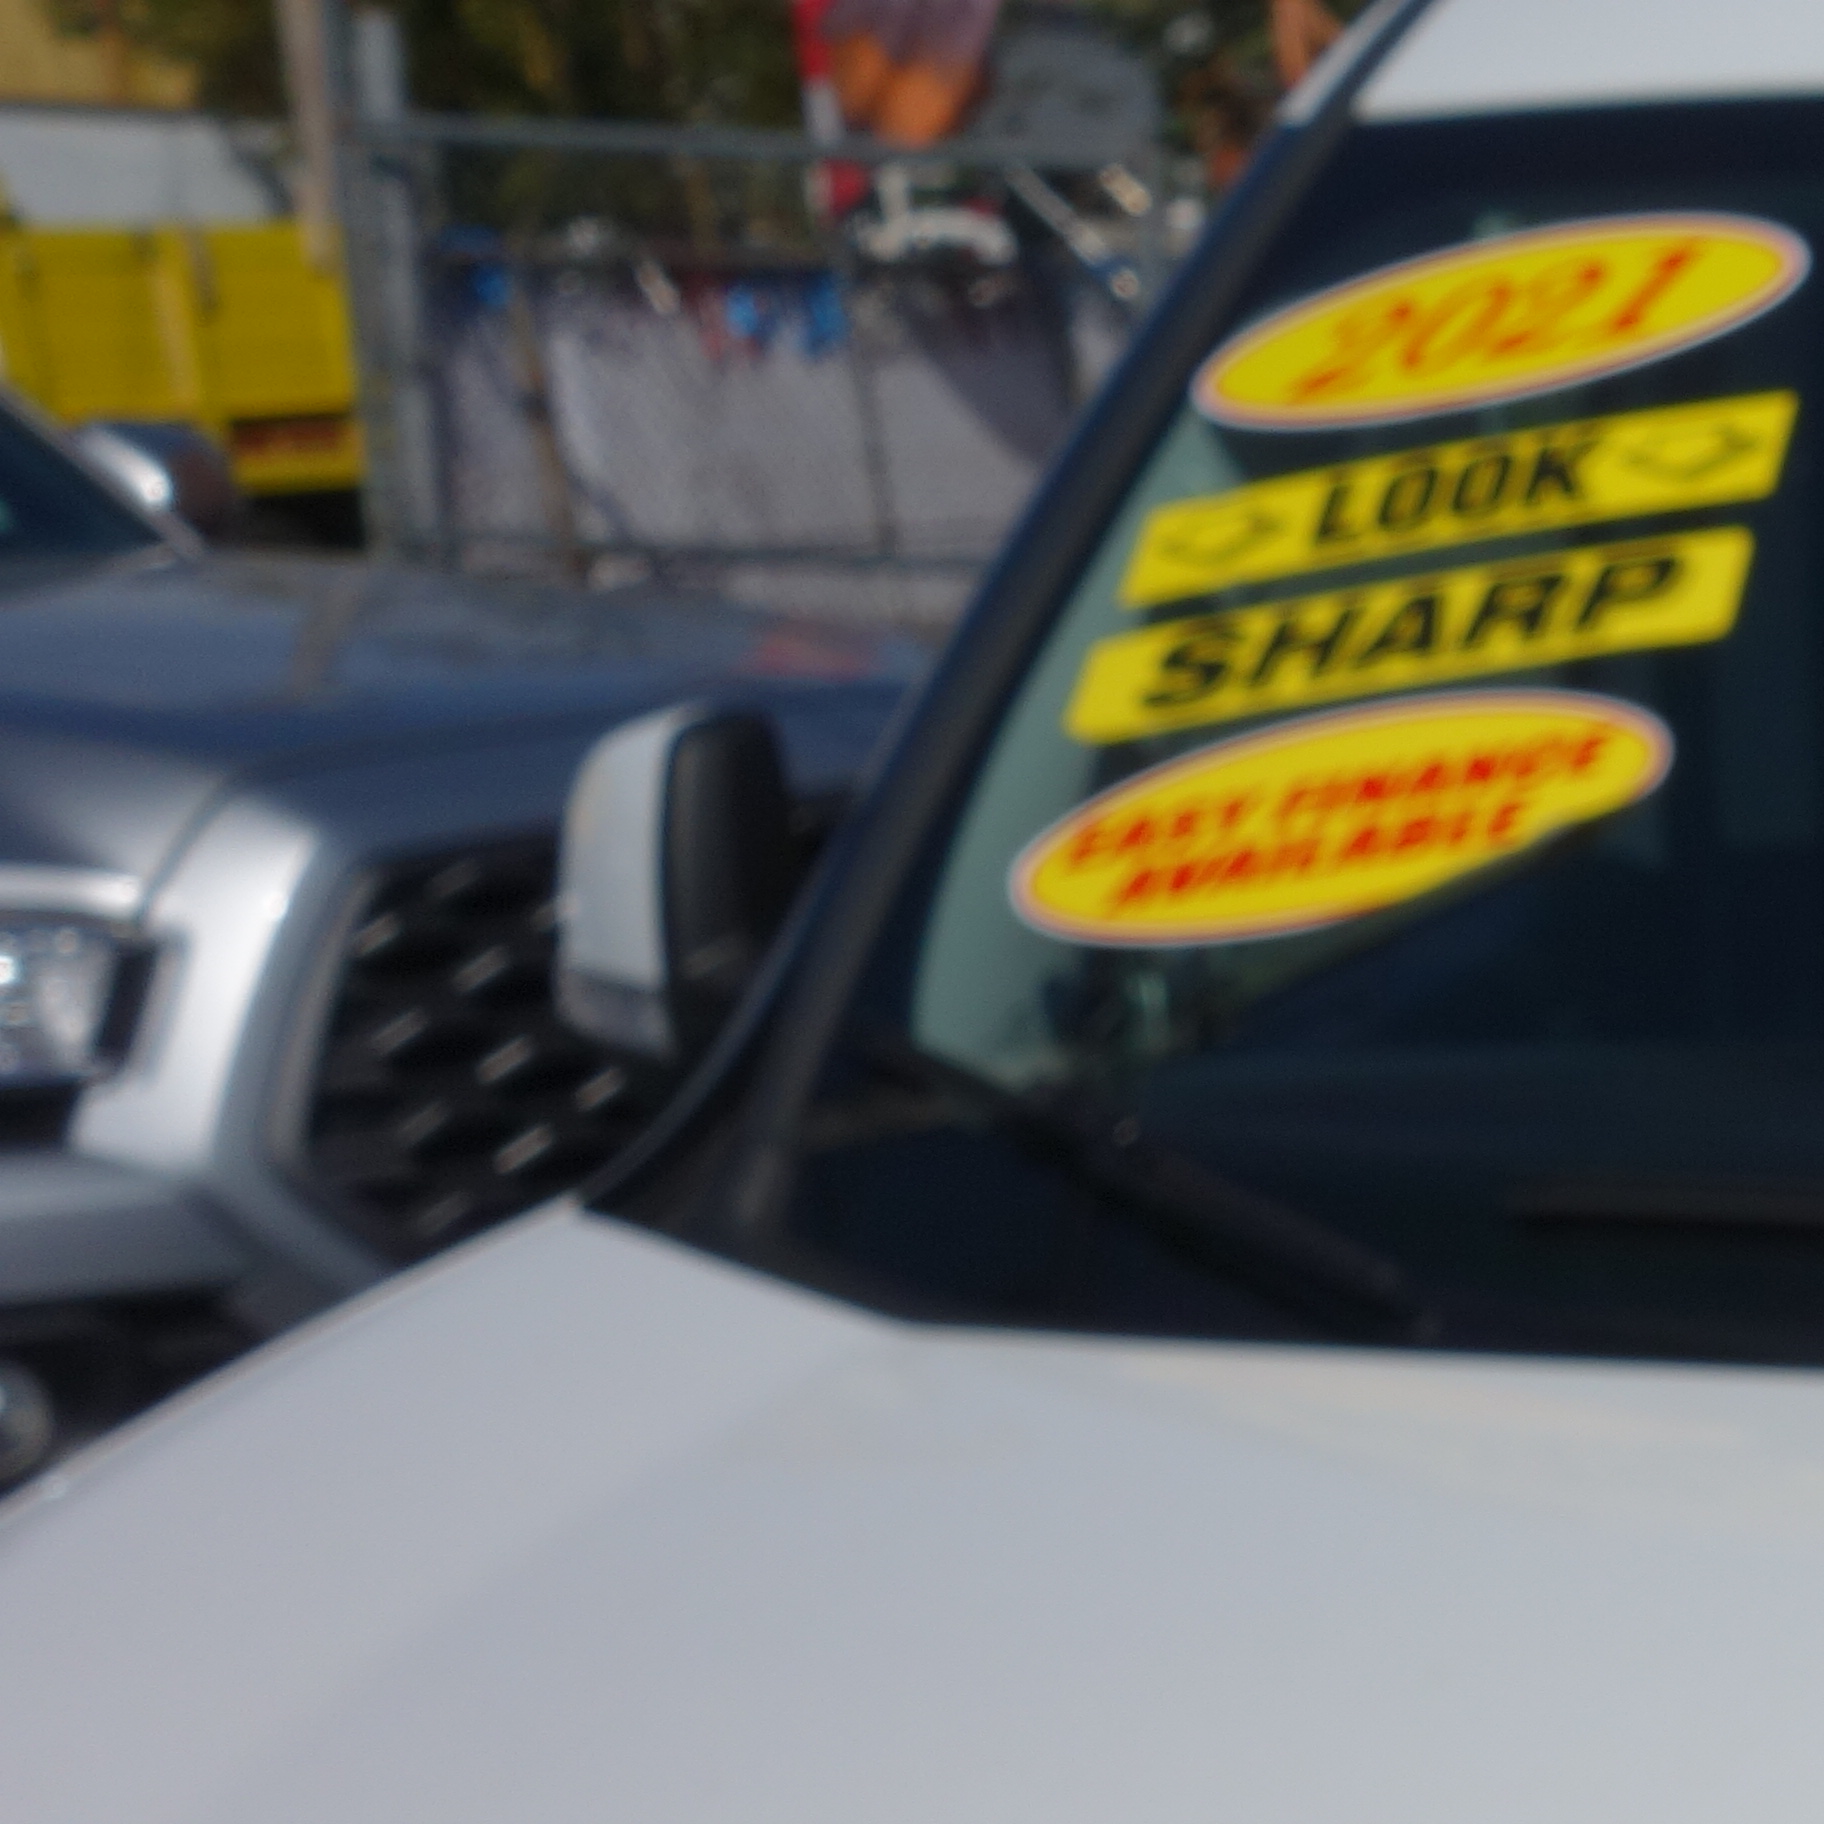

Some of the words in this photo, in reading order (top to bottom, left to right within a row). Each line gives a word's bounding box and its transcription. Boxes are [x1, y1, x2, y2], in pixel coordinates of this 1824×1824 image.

[1288, 234, 1702, 401] 2021
[1313, 439, 1598, 546] LOOK
[1143, 555, 1684, 711] SHARP
[1068, 793, 1252, 870] EASY
[1281, 727, 1616, 815] FINANCE
[1109, 799, 1526, 918] AVAILABLE
